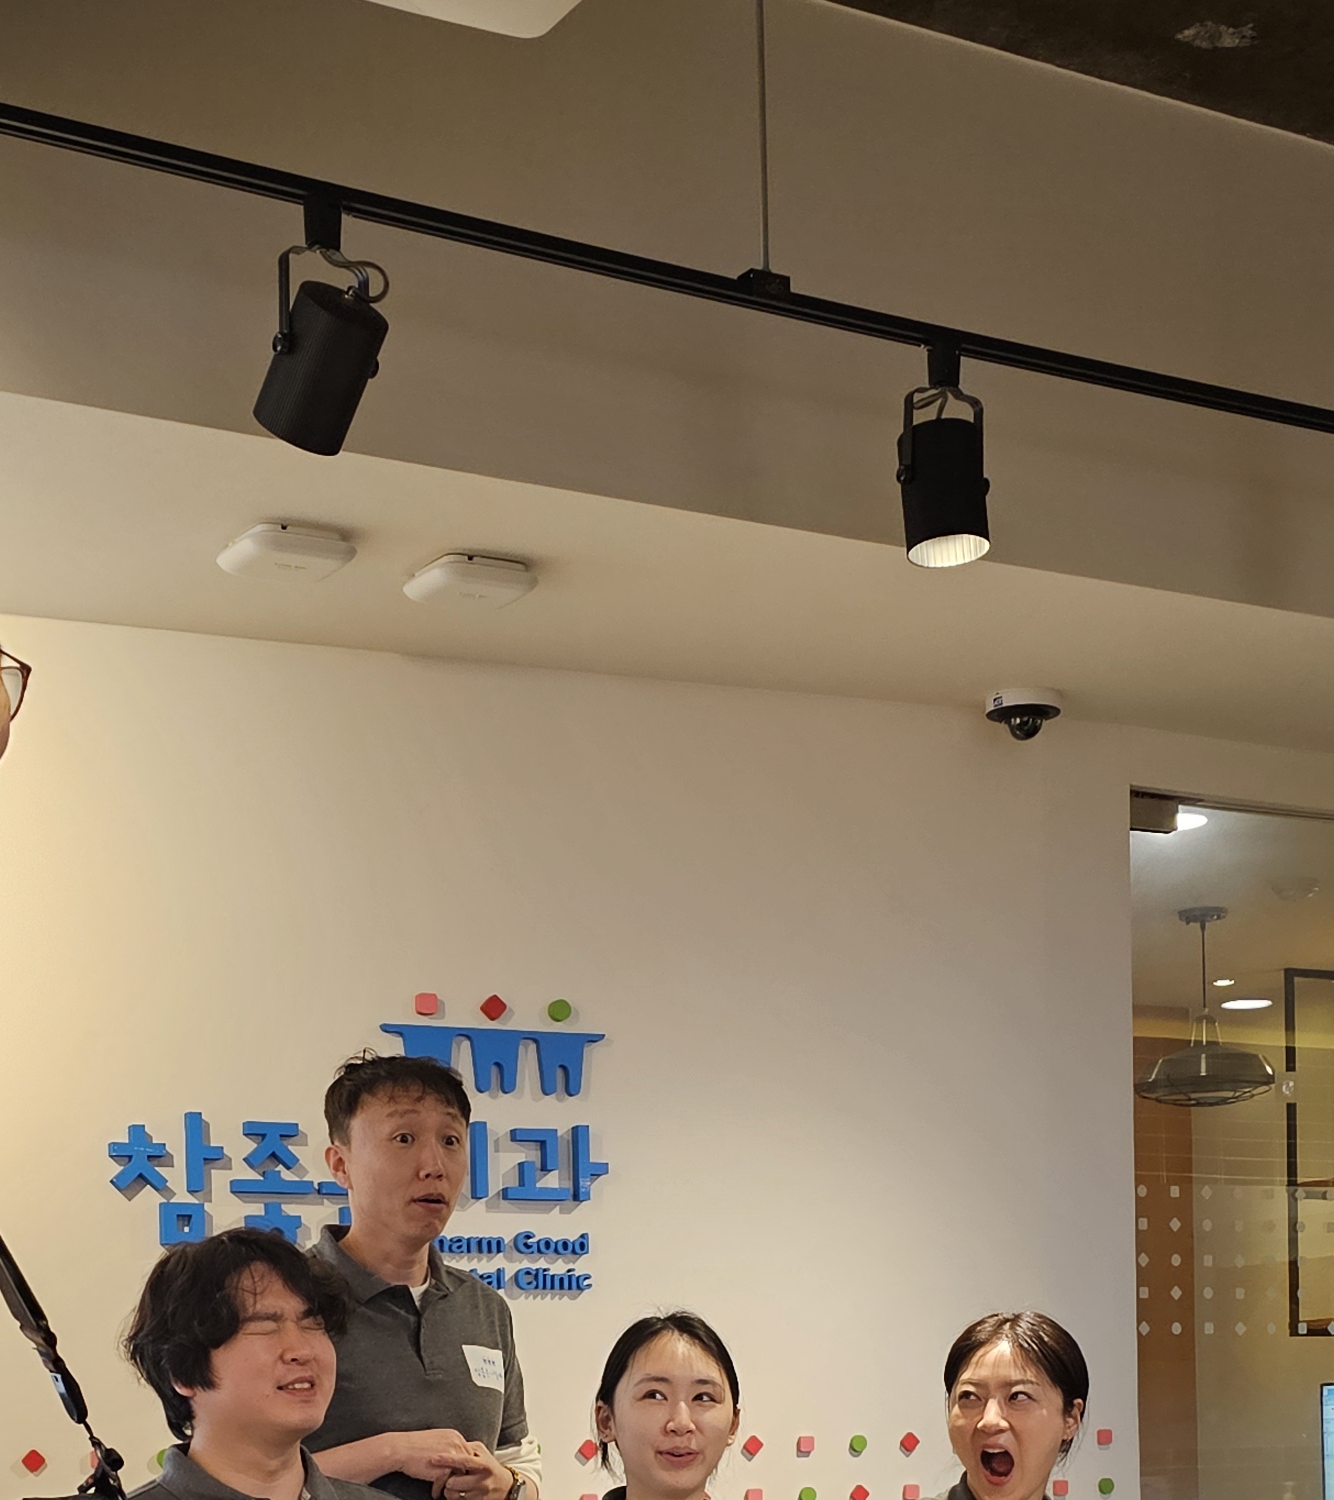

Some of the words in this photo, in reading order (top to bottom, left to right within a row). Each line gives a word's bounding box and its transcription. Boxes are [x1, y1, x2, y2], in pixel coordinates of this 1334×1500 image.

[108, 1110, 609, 1247] 참좋과
[513, 1230, 590, 1256] Good
[514, 1266, 593, 1291] Clinic
